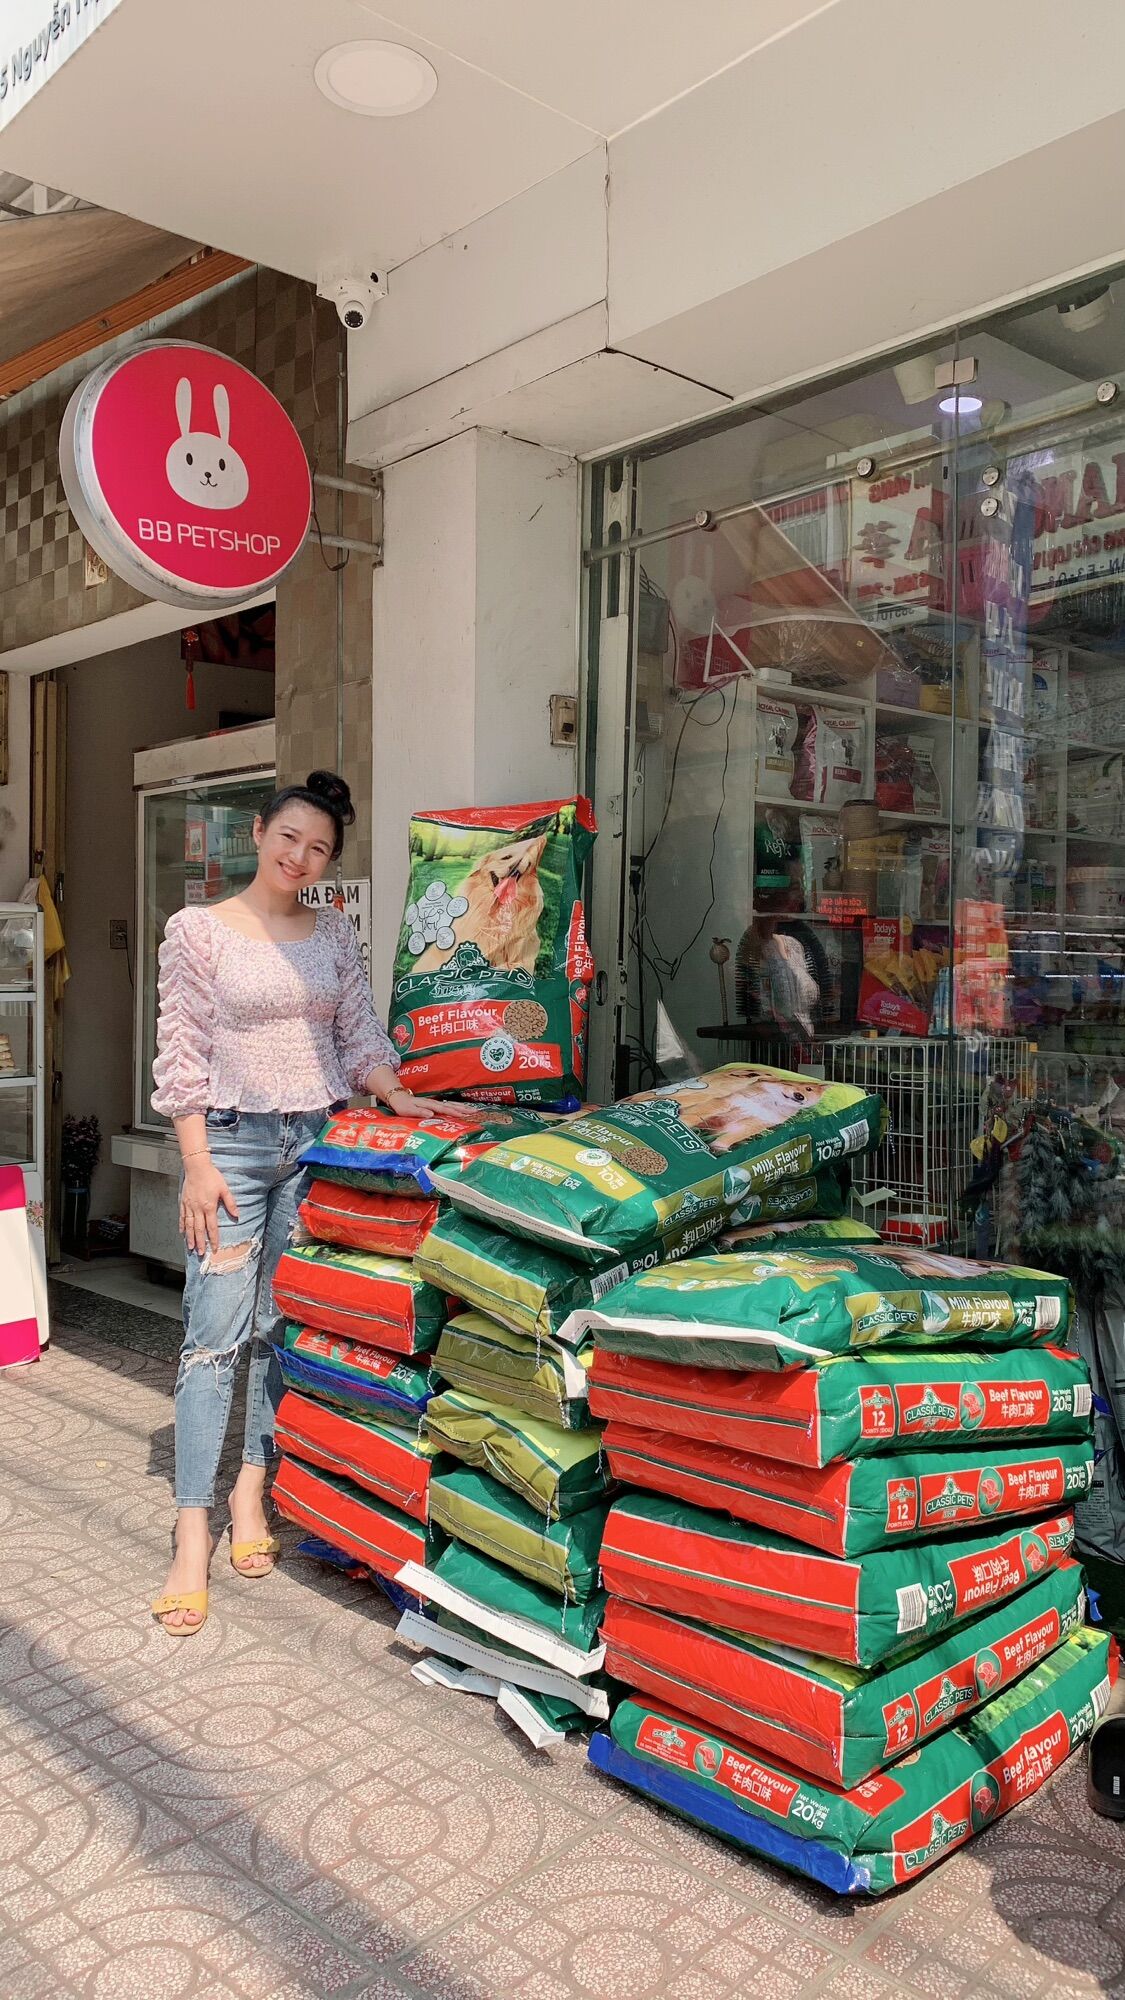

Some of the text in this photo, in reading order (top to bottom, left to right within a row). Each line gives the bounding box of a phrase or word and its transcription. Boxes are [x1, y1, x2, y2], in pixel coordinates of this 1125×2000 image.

[138, 517, 281, 556] BB PETSHOP
[297, 886, 320, 905] HA
[873, 923, 896, 934] Today's
[418, 1007, 498, 1027] Beef Flavour
[429, 1020, 480, 1037] 牛肉口味
[395, 1063, 429, 1078] dult Dog
[480, 1089, 511, 1097] Flavour
[591, 1124, 635, 1146] Flavour
[658, 1117, 700, 1150] PETS
[751, 1143, 808, 1178] Milk Flavour
[664, 1204, 698, 1227] CLASSIC
[632, 1250, 660, 1269] 10kg
[949, 1297, 1010, 1310] Milk Flavour
[858, 1310, 918, 1330] CLASSIC PETS
[989, 1387, 1043, 1402] Beef Flavour
[906, 1406, 956, 1421] CLASSIC PETS
[1001, 1402, 1035, 1419] 牛肉口味
[1052, 1396, 1072, 1413] 20kg
[872, 1410, 886, 1427] 12
[1007, 1468, 1058, 1486] Beef Flavour
[1066, 1475, 1085, 1490] 20kg
[1018, 1483, 1050, 1500] 牛肉口味
[897, 1504, 909, 1520] 12
[926, 1495, 974, 1513] CLASSIC PETS
[1048, 1535, 1065, 1549] PETS
[963, 1579, 1000, 1602] Flavour
[1004, 1620, 1054, 1661] Beef Flavour
[1015, 1641, 1046, 1669] 牛肉口味
[925, 1695, 954, 1723] CLASSIC
[954, 1687, 973, 1701] PETS
[896, 1726, 909, 1743] 12
[1071, 1718, 1094, 1744] 20kg
[1003, 1729, 1062, 1785] Beef lavour
[726, 1755, 793, 1796] Beef Flavour
[732, 1771, 772, 1802] 牛肉口味
[856, 1785, 874, 1798] kg
[798, 1792, 830, 1814] Net Weight
[792, 1800, 824, 1830] 20kg
